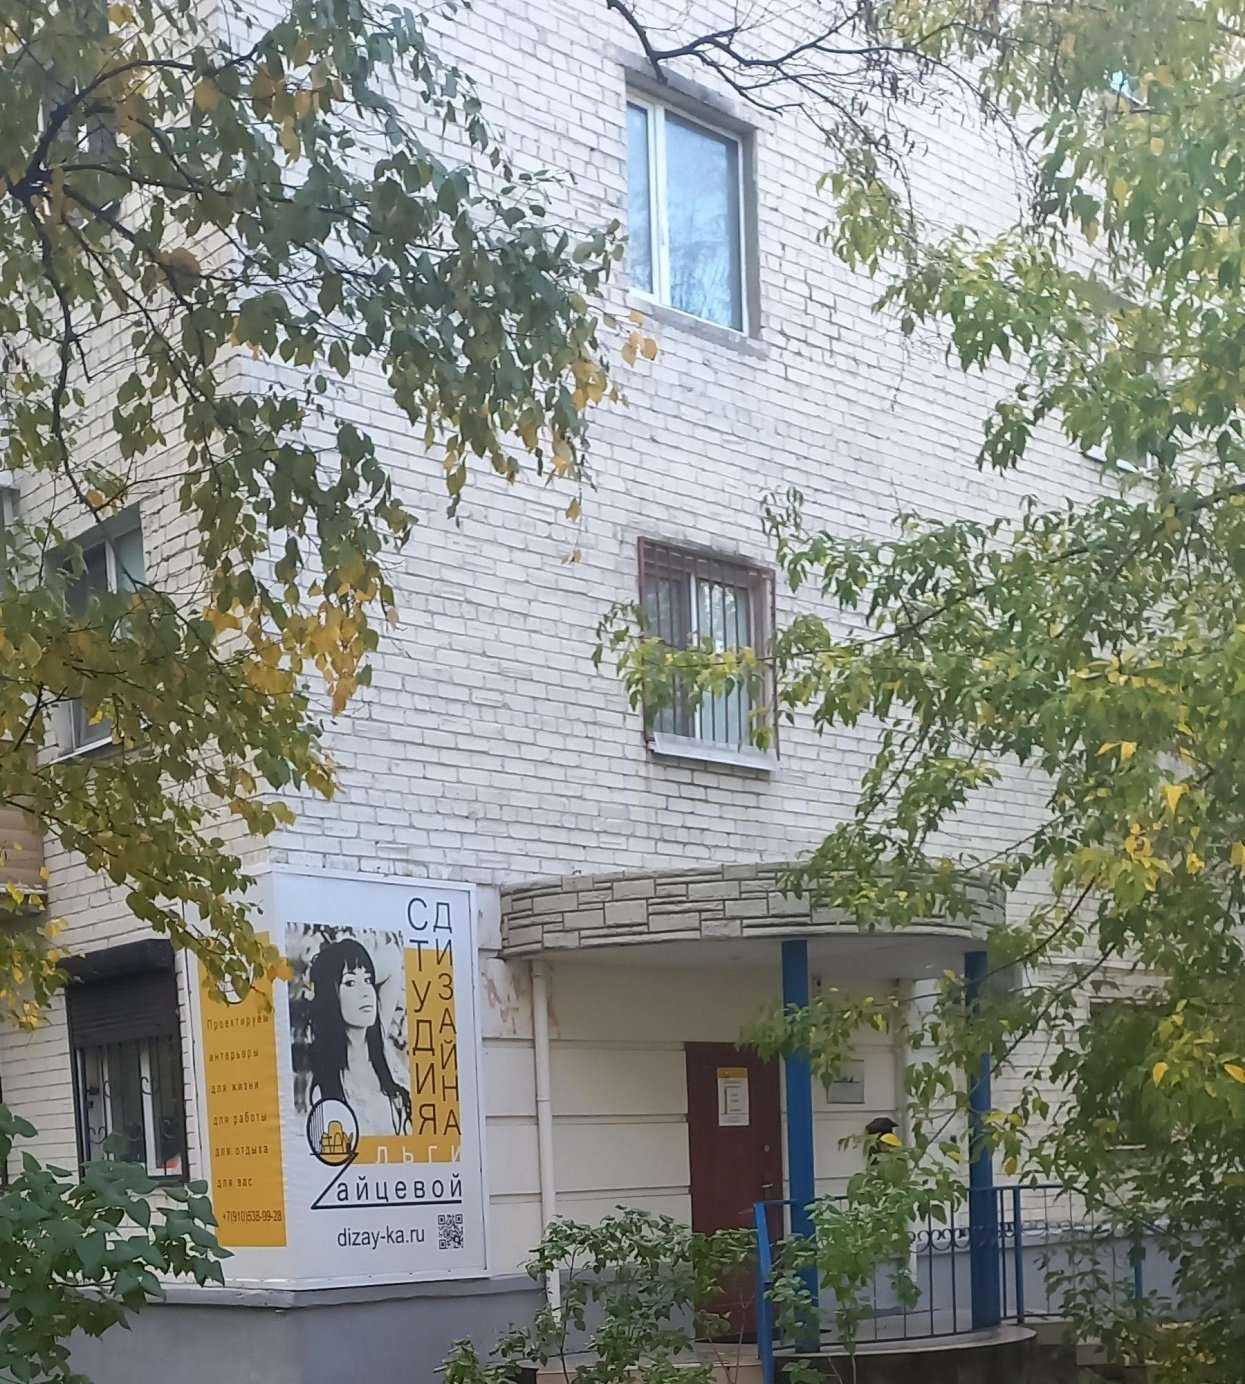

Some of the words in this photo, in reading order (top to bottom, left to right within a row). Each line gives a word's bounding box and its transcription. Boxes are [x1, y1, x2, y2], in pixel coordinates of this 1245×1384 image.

[407, 897, 437, 1136] СТУДИЯ
[433, 902, 462, 1136] ДИЗАЙНА
[211, 1083, 227, 1095] для
[213, 1115, 230, 1126] для
[233, 1111, 267, 1126] работы
[215, 1146, 231, 1157] для
[235, 1144, 269, 1157] отдыха
[216, 1178, 233, 1189] для
[237, 1177, 254, 1188] вас
[337, 1225, 426, 1250] dizay-ka.ru
